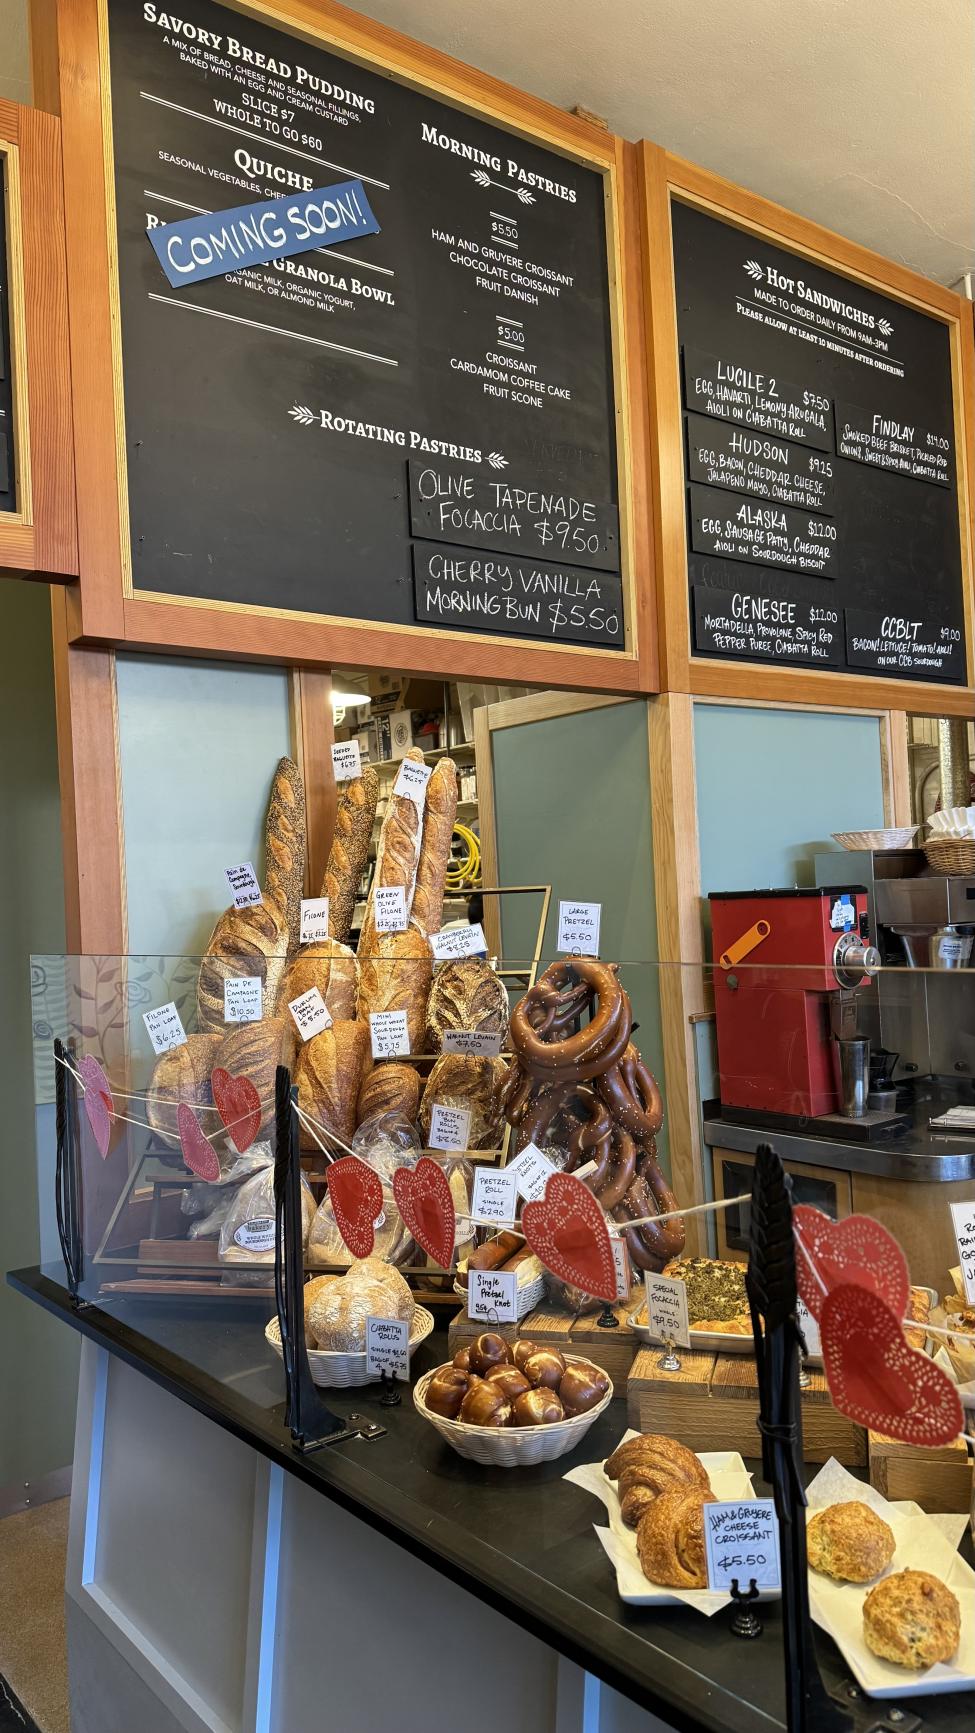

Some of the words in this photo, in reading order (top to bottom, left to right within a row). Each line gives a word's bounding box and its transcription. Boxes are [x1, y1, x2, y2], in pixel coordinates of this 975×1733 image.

[143, 2, 223, 50] SAVORY
[227, 36, 291, 78] BREAD
[295, 66, 375, 114] PUDDING
[163, 36, 170, 44] A
[171, 39, 188, 50] MIX
[190, 45, 201, 56] OF
[204, 50, 234, 70] BREAD,
[235, 64, 266, 84] CHEESE
[268, 76, 285, 91] AND
[287, 84, 327, 109] SEASONAL
[328, 102, 362, 123] FILLINGS,
[180, 53, 208, 69] BAKED
[210, 65, 232, 80] WITH
[233, 75, 246, 85] AN
[247, 80, 265, 93] EGG
[266, 87, 285, 100] AND
[286, 95, 313, 113] CREAM
[315, 106, 348, 126] CUSTARD
[241, 93, 278, 117] SLICE
[281, 109, 295, 123] $7
[213, 99, 261, 128] WHOLE
[263, 118, 280, 135] TO
[283, 126, 299, 142] GO
[301, 134, 323, 151] $60
[158, 150, 206, 175] SEASONAL
[207, 167, 262, 195] VEGETABLES,
[234, 148, 314, 193] QUICHE
[421, 123, 501, 171] MORNING
[507, 159, 577, 203] PASTRIES
[167, 212, 287, 273] COMING
[287, 188, 367, 240] SOON!
[491, 221, 518, 239] $5.50
[431, 228, 455, 246] HAM
[458, 239, 479, 253] AND
[481, 246, 523, 269] GRUYERE
[525, 262, 574, 287] CROISSANT
[273, 257, 348, 291] GRANOLA
[350, 278, 395, 306] BOWL
[449, 252, 508, 281] CHOCOLATE
[510, 272, 561, 298] CROISSANT
[476, 276, 502, 293] FRUIT
[504, 285, 539, 306] DANISH
[225, 273, 242, 285] OAT
[244, 279, 265, 292] MILK,
[267, 286, 279, 296] OR
[281, 289, 315, 308] ALMOND
[316, 300, 335, 313] MILK
[263, 274, 284, 289] MILK,
[286, 282, 322, 299] ORGANIC
[324, 292, 356, 310] YOGURT,
[766, 266, 795, 294] HOT
[797, 280, 875, 329] SANDWICHES
[498, 326, 525, 343] $5.00
[754, 287, 777, 306] MADE
[778, 297, 789, 311] TO
[790, 303, 815, 321] ORDER
[816, 314, 836, 330] DAILY
[837, 323, 856, 339] FROM
[857, 331, 889, 352] 9AM-3PM
[736, 302, 763, 322] PLEASE
[764, 313, 788, 332] ALLOW
[789, 326, 798, 336] AT
[798, 329, 818, 344] LEAST
[819, 338, 826, 347] 10
[826, 341, 854, 358] MINUTES
[855, 352, 874, 366] AFTER
[874, 360, 905, 378] ORDERING
[450, 358, 508, 383] CARDAMOM
[510, 375, 546, 393] COFFEE
[547, 385, 571, 400] CAKE
[486, 352, 537, 375] CROISSANT
[483, 383, 509, 399] FRUIT
[511, 391, 543, 408] SCONE
[695, 377, 716, 400] EGG,
[755, 395, 787, 418] LEMONY
[717, 360, 765, 393] LUCILE
[768, 378, 779, 397] 2
[803, 390, 830, 411] $7.50
[706, 400, 730, 417] AIOLI
[732, 408, 743, 419] ON
[746, 410, 787, 434] CIABATTA
[789, 423, 806, 438] ROLL
[872, 414, 915, 442] FINDLAY
[319, 409, 406, 446] ROTATING
[409, 430, 482, 463] PASTRIES
[728, 432, 789, 465] HUDSON
[699, 448, 719, 468] EGG,
[719, 453, 746, 476] BACON,
[747, 461, 791, 487] CHEDDAR
[794, 474, 826, 496] CHEESE,
[418, 469, 475, 499] OLIVE
[488, 483, 597, 522] TAPENADE
[439, 501, 522, 537] FOCACCIA
[533, 518, 599, 554] $9.50
[736, 504, 788, 532] ALASKA
[701, 518, 723, 537] EGG,
[725, 520, 765, 544] SAUSAGE
[767, 531, 792, 553] PATTY,
[793, 536, 831, 559] CHEDDAR
[714, 539, 735, 552] AIOLI
[738, 545, 749, 555] ON
[752, 544, 797, 565] SOURDOUGH
[799, 557, 826, 570] BISCUIT
[428, 554, 513, 592] CHERRY
[519, 568, 601, 601] VANILLA
[426, 586, 501, 616] MORNING
[502, 596, 540, 623] BUN
[548, 598, 619, 634] $5.50
[731, 593, 797, 624] GENESEE
[809, 605, 838, 624] $12.00
[881, 616, 923, 640] CCBLT
[562, 932, 592, 941] $5.50
[563, 916, 594, 925] PRETZEL
[226, 980, 240, 988] PAIN
[226, 989, 260, 997] CAMPAGNE
[479, 1177, 511, 1186] PRETZEL
[484, 1186, 503, 1194] ROLL
[477, 1274, 500, 1291] Single
[480, 1288, 505, 1300] Pretzel
[652, 1284, 678, 1296] SPECIAL
[494, 1299, 511, 1308] Knot
[650, 1292, 680, 1308] FOCACCIA
[371, 1323, 402, 1335] CIABATTA
[378, 1332, 399, 1341] ROLLS
[652, 1314, 680, 1329] $9.50
[714, 1530, 772, 1545] CROISSANT
[724, 1521, 760, 1532] CHEESE
[717, 1554, 767, 1572] $5.50
